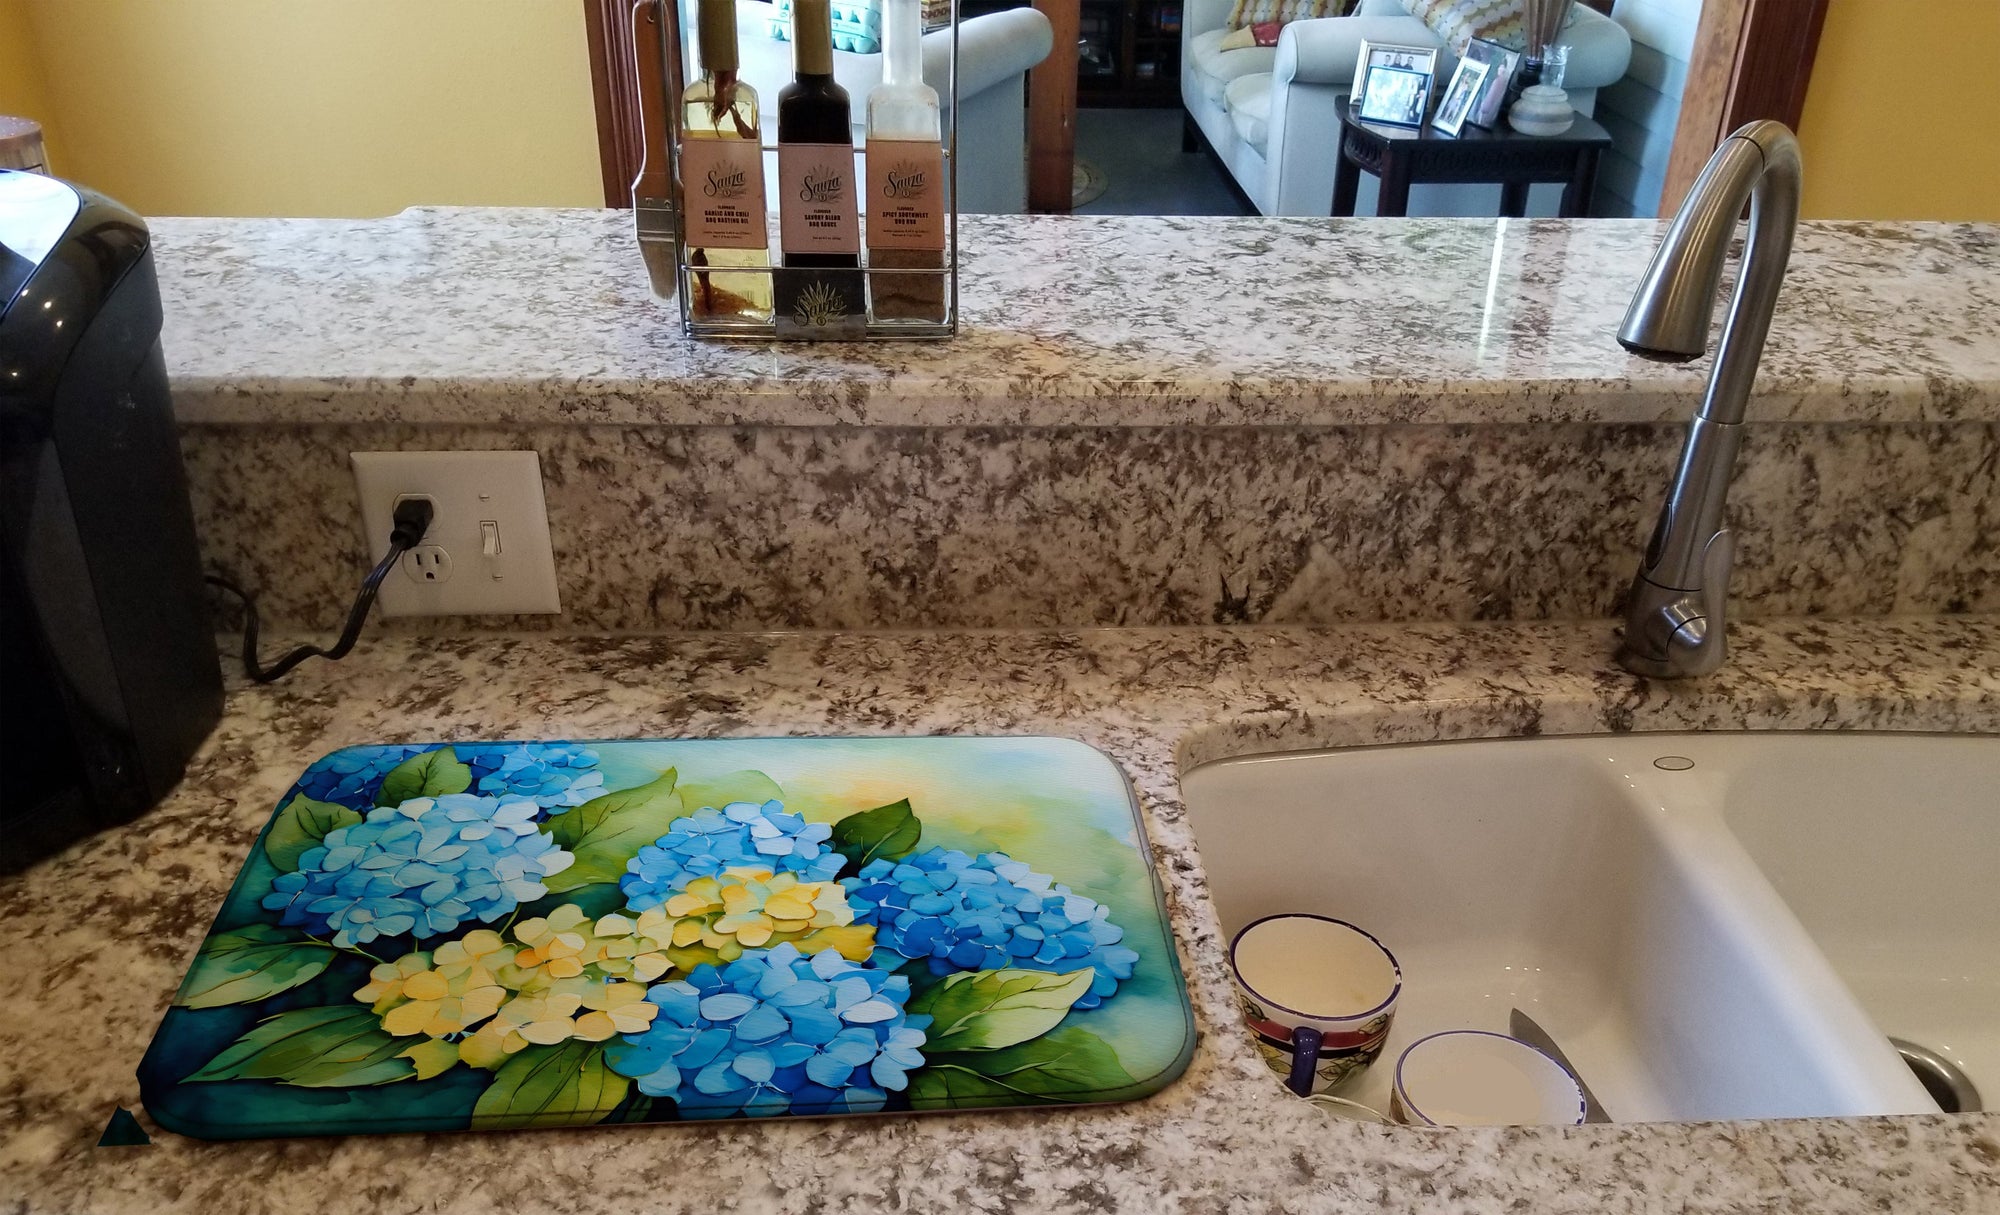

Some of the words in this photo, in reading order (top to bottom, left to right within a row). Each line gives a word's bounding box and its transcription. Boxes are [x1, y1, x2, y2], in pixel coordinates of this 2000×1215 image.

[704, 170, 745, 197] Sauza
[800, 176, 842, 202] Sauza
[884, 172, 925, 198] Sauza
